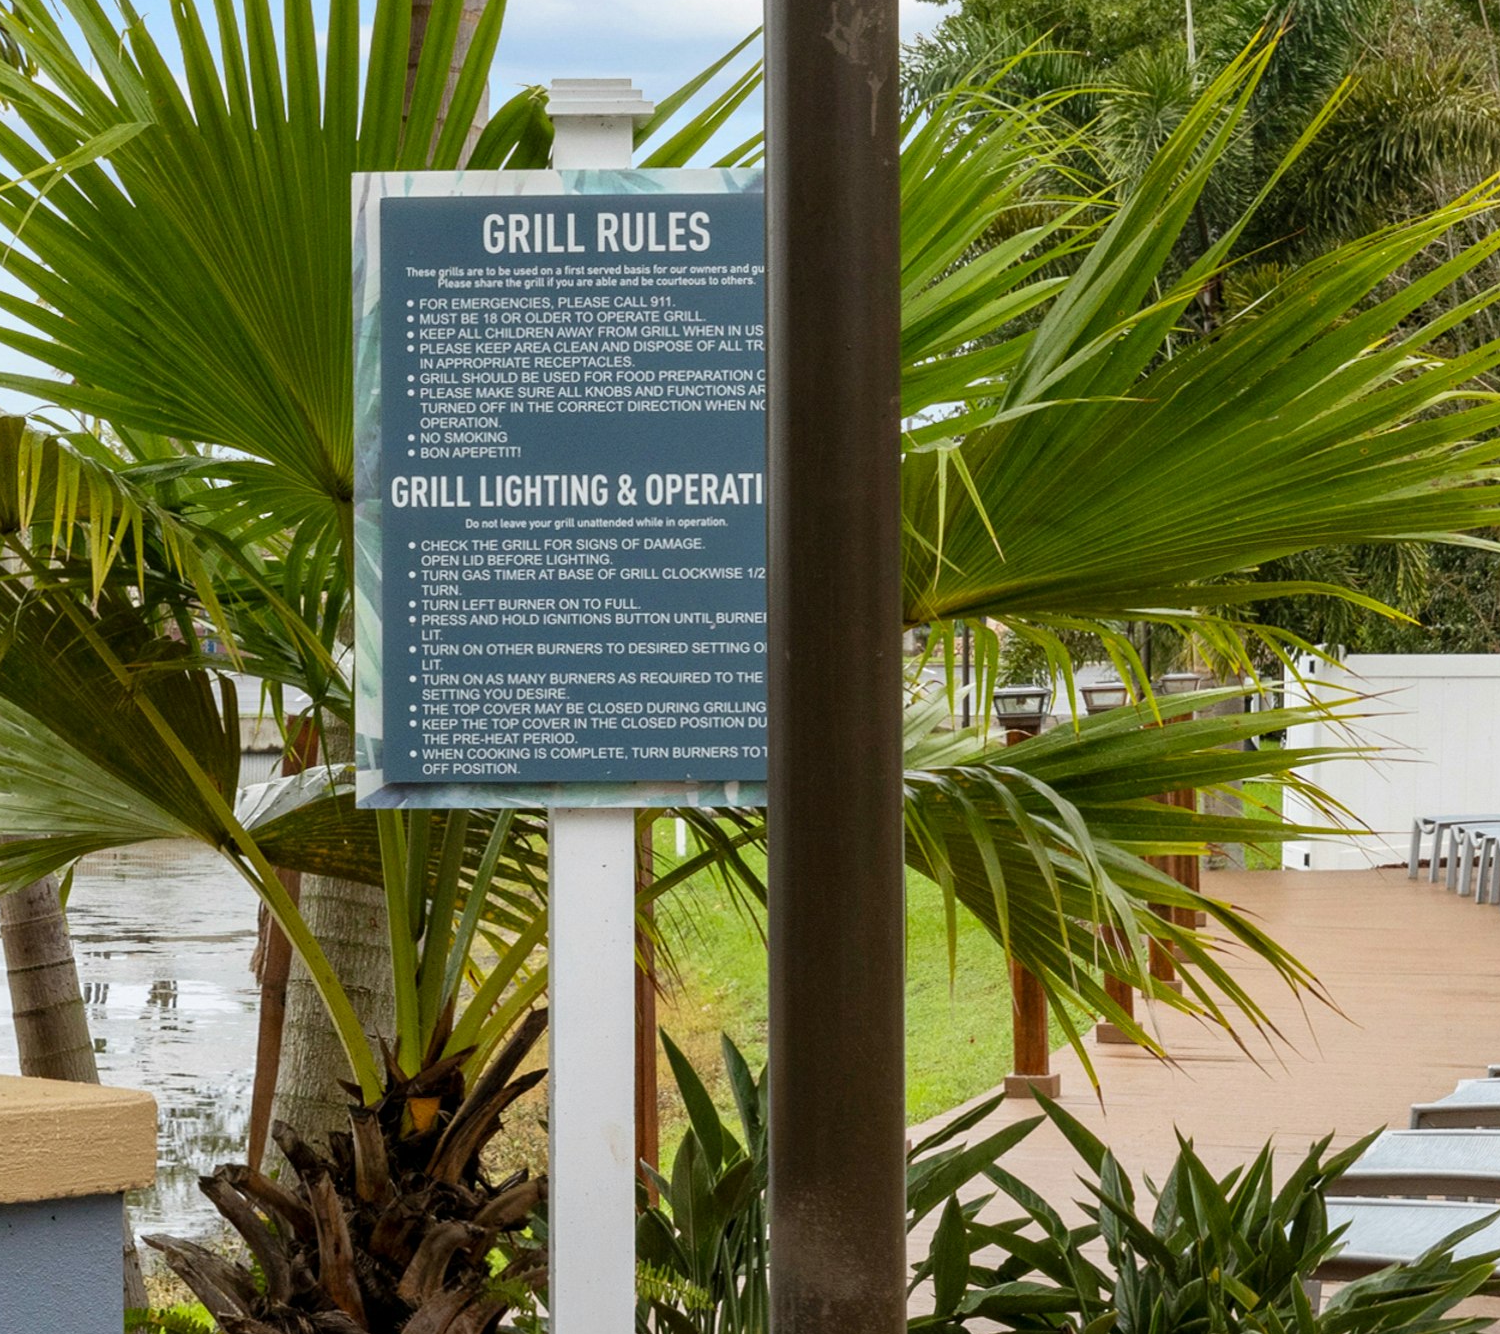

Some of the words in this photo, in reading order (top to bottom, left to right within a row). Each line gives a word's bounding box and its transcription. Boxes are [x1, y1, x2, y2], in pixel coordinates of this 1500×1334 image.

[483, 213, 585, 254] GRILL
[598, 211, 710, 252] RULES
[438, 278, 472, 288] Please
[474, 278, 503, 288] share
[505, 278, 522, 288] the
[524, 278, 545, 290] grill
[547, 277, 554, 287] if
[556, 279, 574, 289] you
[576, 279, 593, 287] are
[595, 277, 617, 286] able
[619, 276, 639, 286] and
[641, 276, 654, 286] be
[656, 277, 707, 286] courteous
[709, 276, 719, 285] to
[721, 275, 756, 285] others.
[420, 298, 448, 310] FOR
[451, 297, 554, 309] EMERGENCIES,
[558, 296, 610, 308] PLEASE
[614, 296, 648, 308] CALL
[650, 296, 675, 308] 911.
[420, 313, 457, 325] MUST
[461, 313, 478, 324] BE
[484, 313, 498, 324] 18
[501, 312, 521, 324] OR
[525, 312, 571, 324] OLDER
[575, 311, 593, 323] TO
[597, 311, 660, 323] OPERATE
[664, 310, 706, 322] GRILL.
[420, 328, 456, 340] KEEP
[458, 328, 482, 339] ALL
[485, 327, 554, 339] CHILDREN
[556, 327, 594, 338] AWAY
[598, 326, 637, 338] FROM
[641, 325, 680, 337] GRILL
[683, 325, 724, 337] WHEN
[728, 325, 741, 336] IN
[420, 343, 472, 355] PLEASE
[476, 342, 512, 354] KEEP
[514, 342, 551, 353] AREA
[553, 341, 598, 353] CLEAN
[601, 341, 630, 352] AND
[633, 340, 693, 352] DISPOSE
[696, 340, 715, 352] OF
[718, 340, 742, 351] ALL
[420, 358, 433, 369] IN
[436, 357, 530, 369] APPROPRIATE
[534, 356, 635, 368] RECEPTACLES.
[420, 373, 459, 384] GRILL
[462, 372, 518, 384] SHOULD
[521, 372, 539, 383] BE
[543, 371, 580, 383] USED
[584, 371, 612, 383] FOR
[616, 370, 655, 382] FOOD
[659, 369, 753, 382] PREPARATION
[420, 402, 476, 414] TURNED
[479, 402, 506, 413] OFF
[510, 402, 523, 412] IN
[527, 401, 554, 413] THE
[557, 400, 624, 413] CORRECT
[628, 400, 701, 412] DIRECTION
[705, 399, 746, 411] WHEN
[420, 417, 501, 429] OPERATION.
[420, 432, 441, 444] NO
[444, 431, 508, 443] SMOKING
[421, 447, 449, 459] BON
[452, 446, 521, 458] APEPETIT!
[392, 476, 470, 508] GRILL
[480, 474, 608, 507] LIGHTING
[617, 474, 637, 506] &
[646, 473, 762, 505] OPERATI
[465, 518, 479, 529] Do
[482, 519, 498, 528] not
[500, 519, 527, 528] leave
[529, 520, 552, 530] your
[554, 518, 575, 530] grill
[577, 518, 634, 528] unattended
[636, 517, 663, 527] while
[666, 517, 675, 526] in
[678, 517, 728, 528] operation.
[421, 540, 468, 551] CHECK
[471, 539, 498, 551] THE
[502, 539, 541, 551] GRILL
[544, 539, 572, 551] FOR
[576, 538, 618, 550] SIGNS
[621, 538, 640, 550] OF
[644, 538, 705, 550] DAMAGE.
[421, 555, 459, 566] OPEN
[463, 555, 484, 566] LID
[487, 554, 543, 566] BEFORE
[546, 553, 613, 565] LIGHTING.
[421, 570, 458, 581] TURN
[462, 569, 491, 581] GAS
[494, 569, 536, 581] TIMER
[538, 569, 555, 580] AT
[558, 569, 594, 580] BASE
[598, 568, 616, 580] OF
[620, 568, 659, 580] GRILL
[662, 567, 743, 579] CLOCKWISE
[748, 567, 766, 579] 1/2
[421, 584, 462, 596] TURN.
[421, 599, 459, 611] TURN
[462, 599, 495, 611] LEFT
[499, 598, 555, 610] BURNER
[559, 598, 579, 610] ON
[582, 598, 601, 610] TO
[605, 598, 641, 610] FULL.
[422, 629, 443, 641] LIT.
[422, 659, 443, 671] LIT.
[422, 674, 459, 686] TURN
[463, 674, 483, 685] ON
[485, 673, 504, 685] AS
[508, 673, 546, 684] MANY
[550, 673, 616, 685] BURNERS
[618, 672, 636, 684] AS
[640, 672, 711, 684] REQUIRED
[714, 672, 733, 683] TO
[736, 672, 763, 683] THE
[422, 688, 480, 700] SETTING
[483, 688, 513, 700] YOU
[516, 688, 569, 700] DESIRE.
[422, 704, 449, 715] THE
[452, 703, 480, 715] TOP
[483, 703, 531, 715] COVER
[535, 703, 563, 714] MAY
[566, 702, 584, 714] BE
[588, 702, 643, 714] CLOSED
[647, 702, 700, 714] DURING
[422, 718, 458, 730] KEEP
[461, 718, 488, 730] THE
[491, 718, 519, 730] TOP
[522, 718, 570, 730] COVER
[574, 718, 587, 729] IN
[591, 717, 617, 729] THE
[621, 717, 677, 729] CLOSED
[680, 716, 744, 728] POSITION
[422, 733, 449, 745] THE
[453, 733, 520, 745] PRE-HEAT
[523, 732, 577, 744] PERIOD.
[422, 763, 449, 775] OFF
[453, 763, 520, 774] POSITION.
